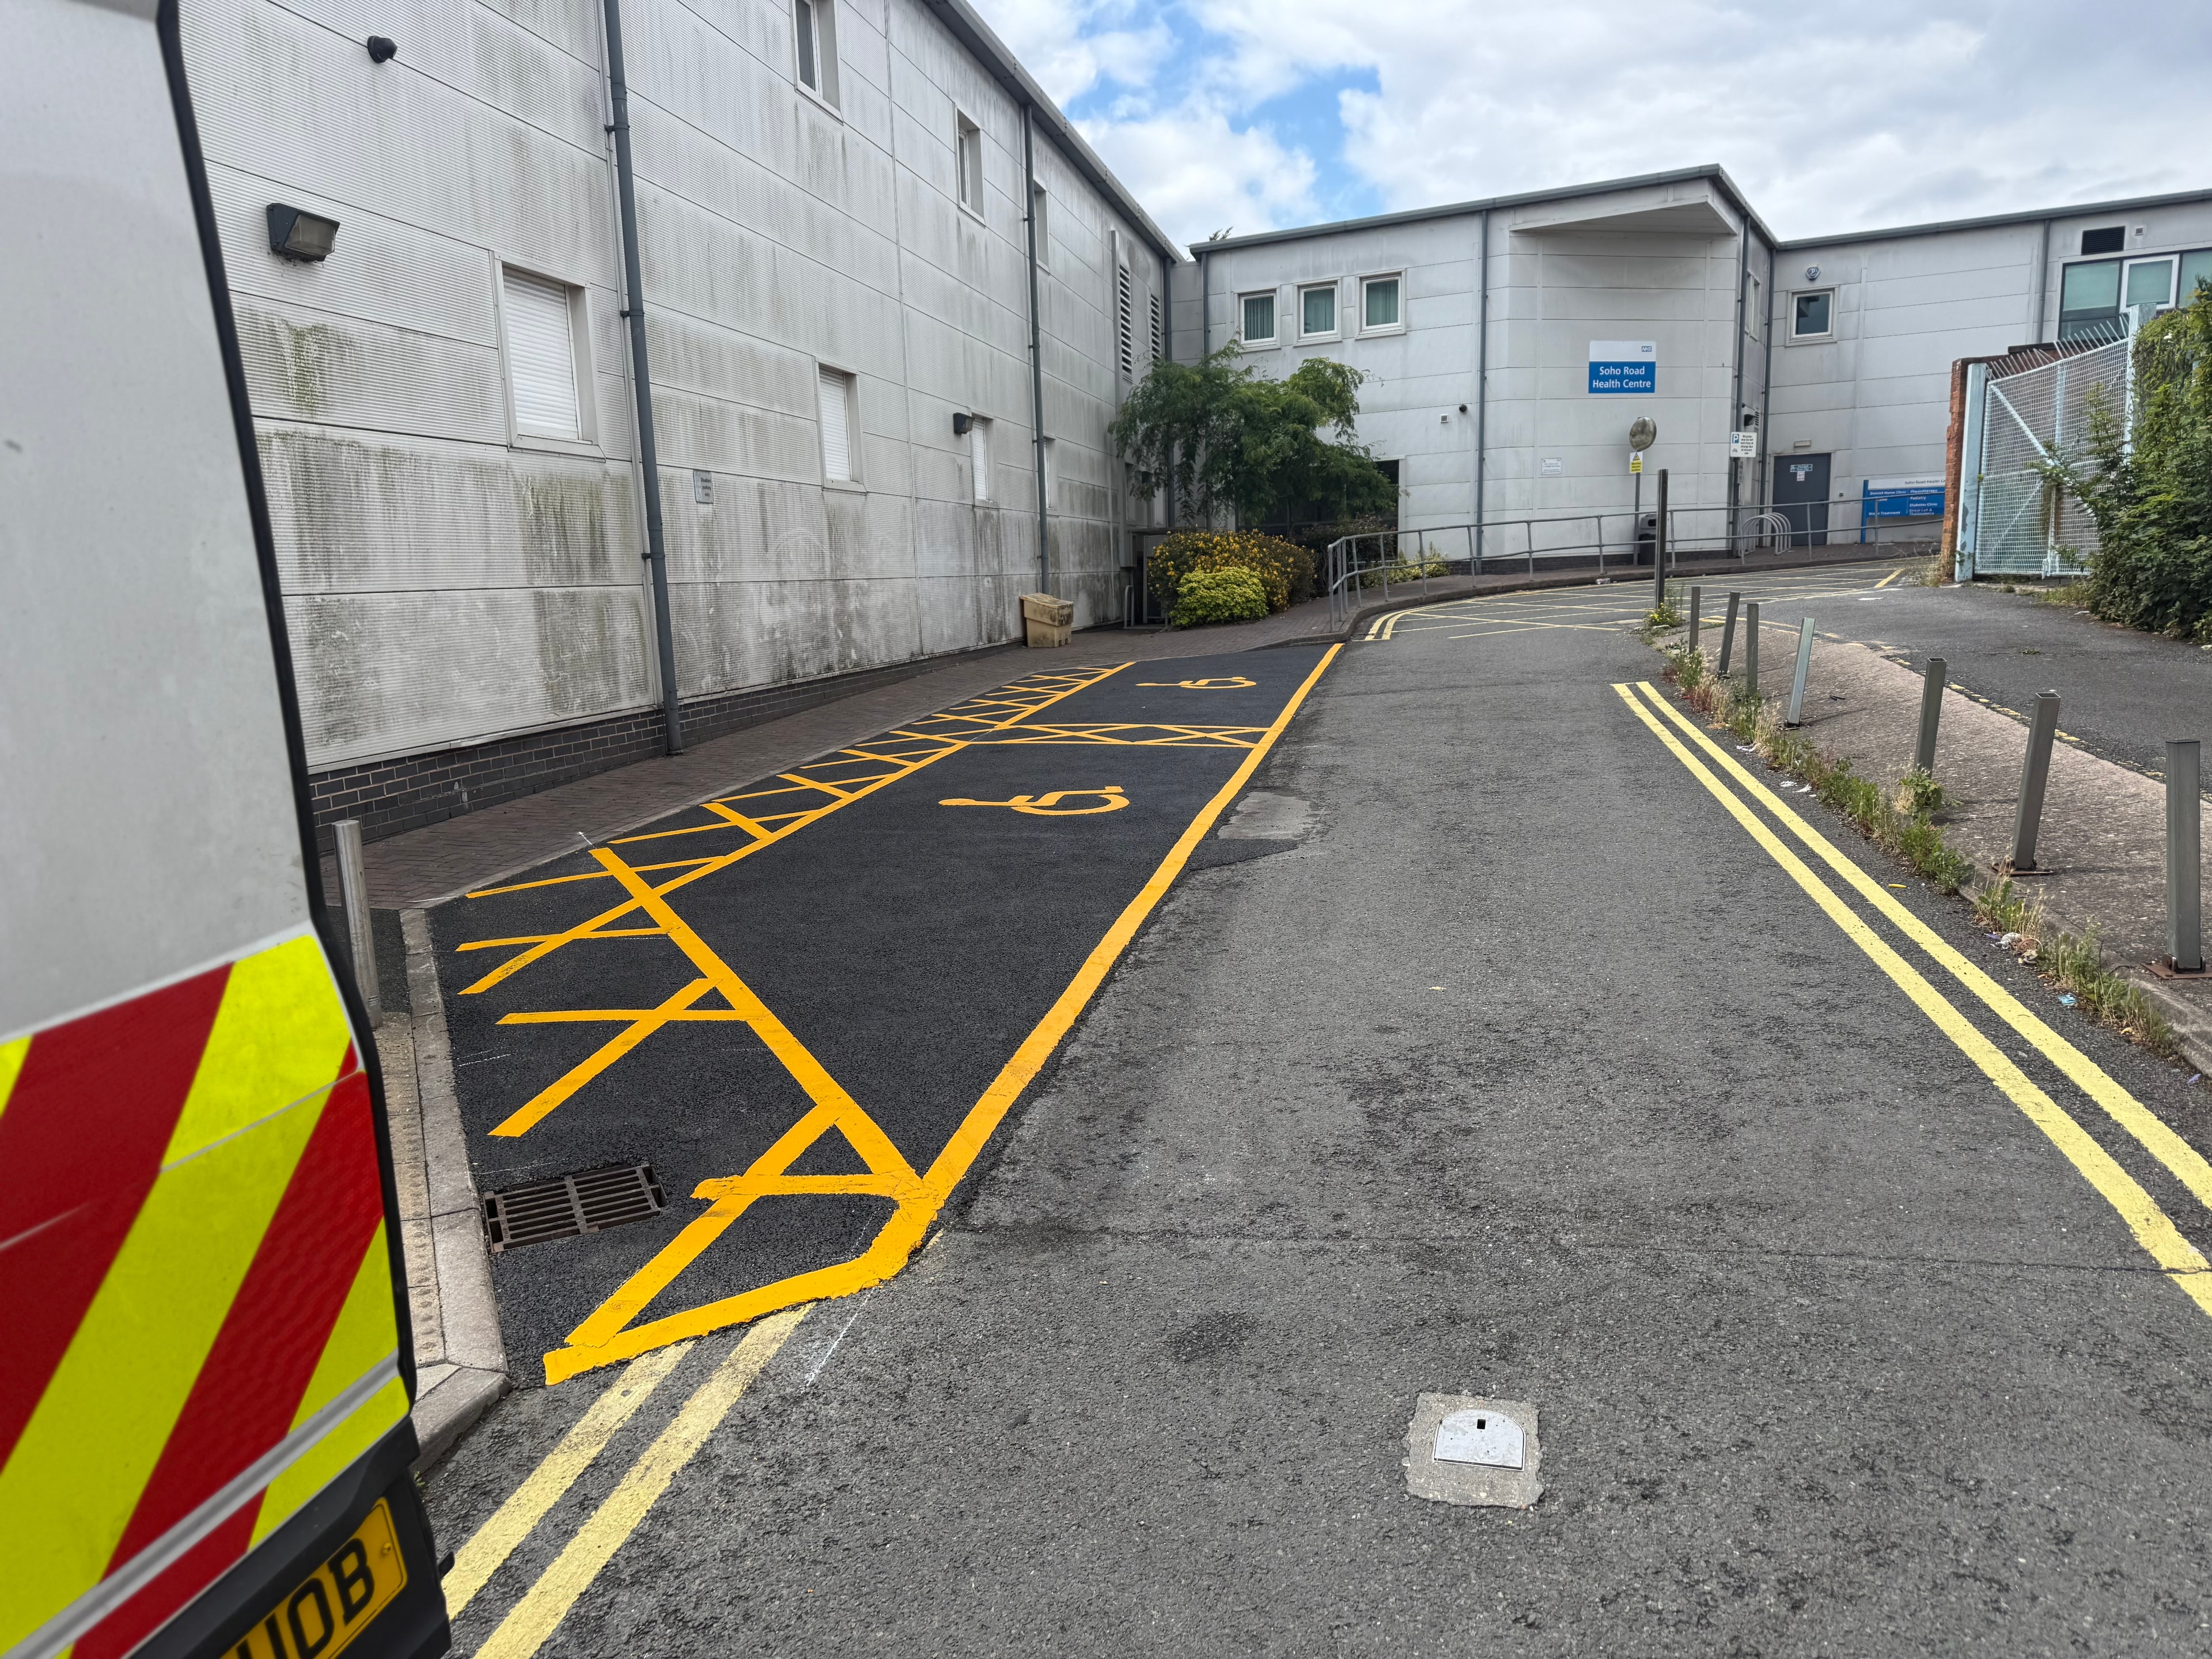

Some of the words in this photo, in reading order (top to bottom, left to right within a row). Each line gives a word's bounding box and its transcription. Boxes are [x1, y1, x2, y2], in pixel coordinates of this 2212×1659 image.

[1600, 366, 1621, 374] Soho
[1624, 366, 1645, 374] Road
[1593, 379, 1620, 388] Health
[1623, 379, 1651, 388] Centre
[1733, 434, 1738, 443] P
